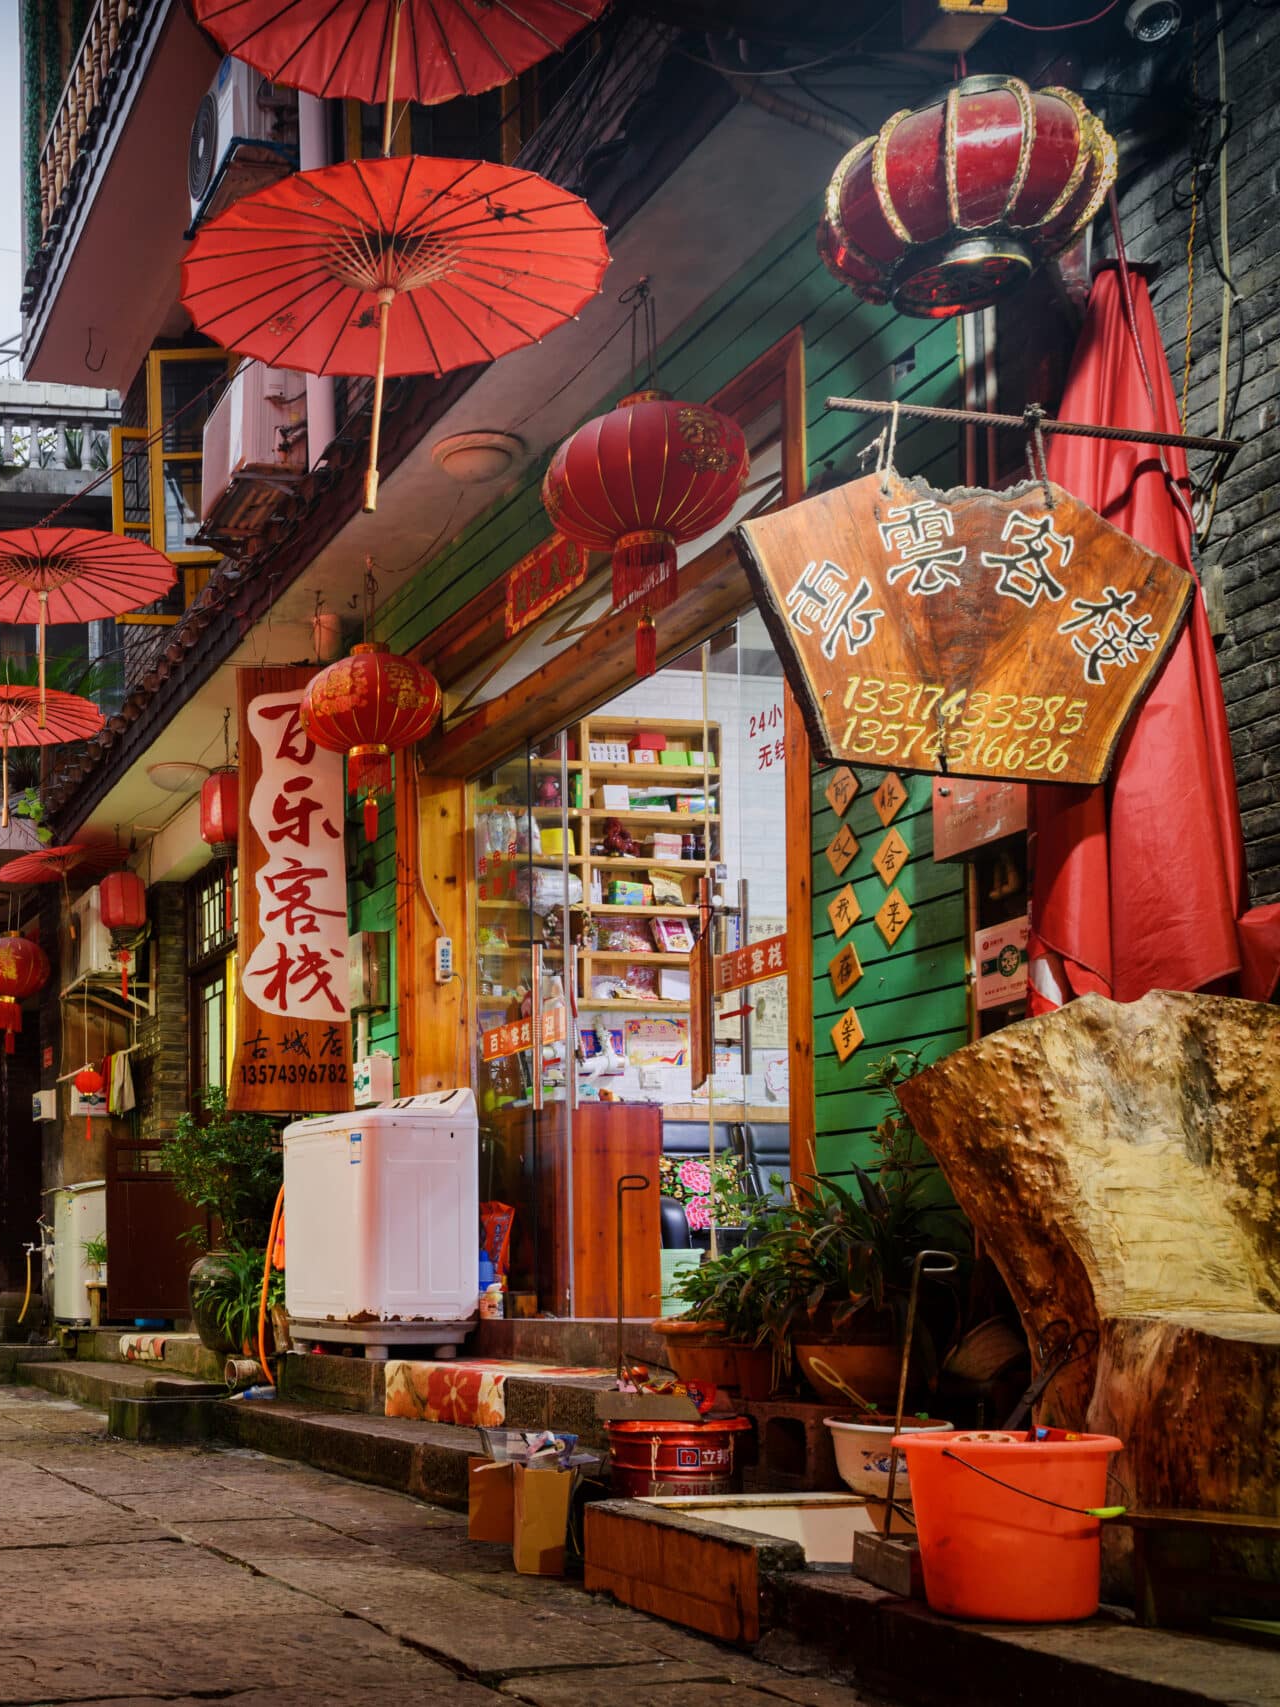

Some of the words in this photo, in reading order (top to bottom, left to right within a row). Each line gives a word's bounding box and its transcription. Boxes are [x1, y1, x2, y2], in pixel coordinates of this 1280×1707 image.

[842, 674, 1087, 736] 13317433385
[840, 715, 1071, 774] 13574316626
[248, 703, 347, 1014] 百乐客栈
[243, 1026, 344, 1060] 古城店
[240, 1062, 347, 1087] 13574396782
[701, 1448, 729, 1465] 立邦
